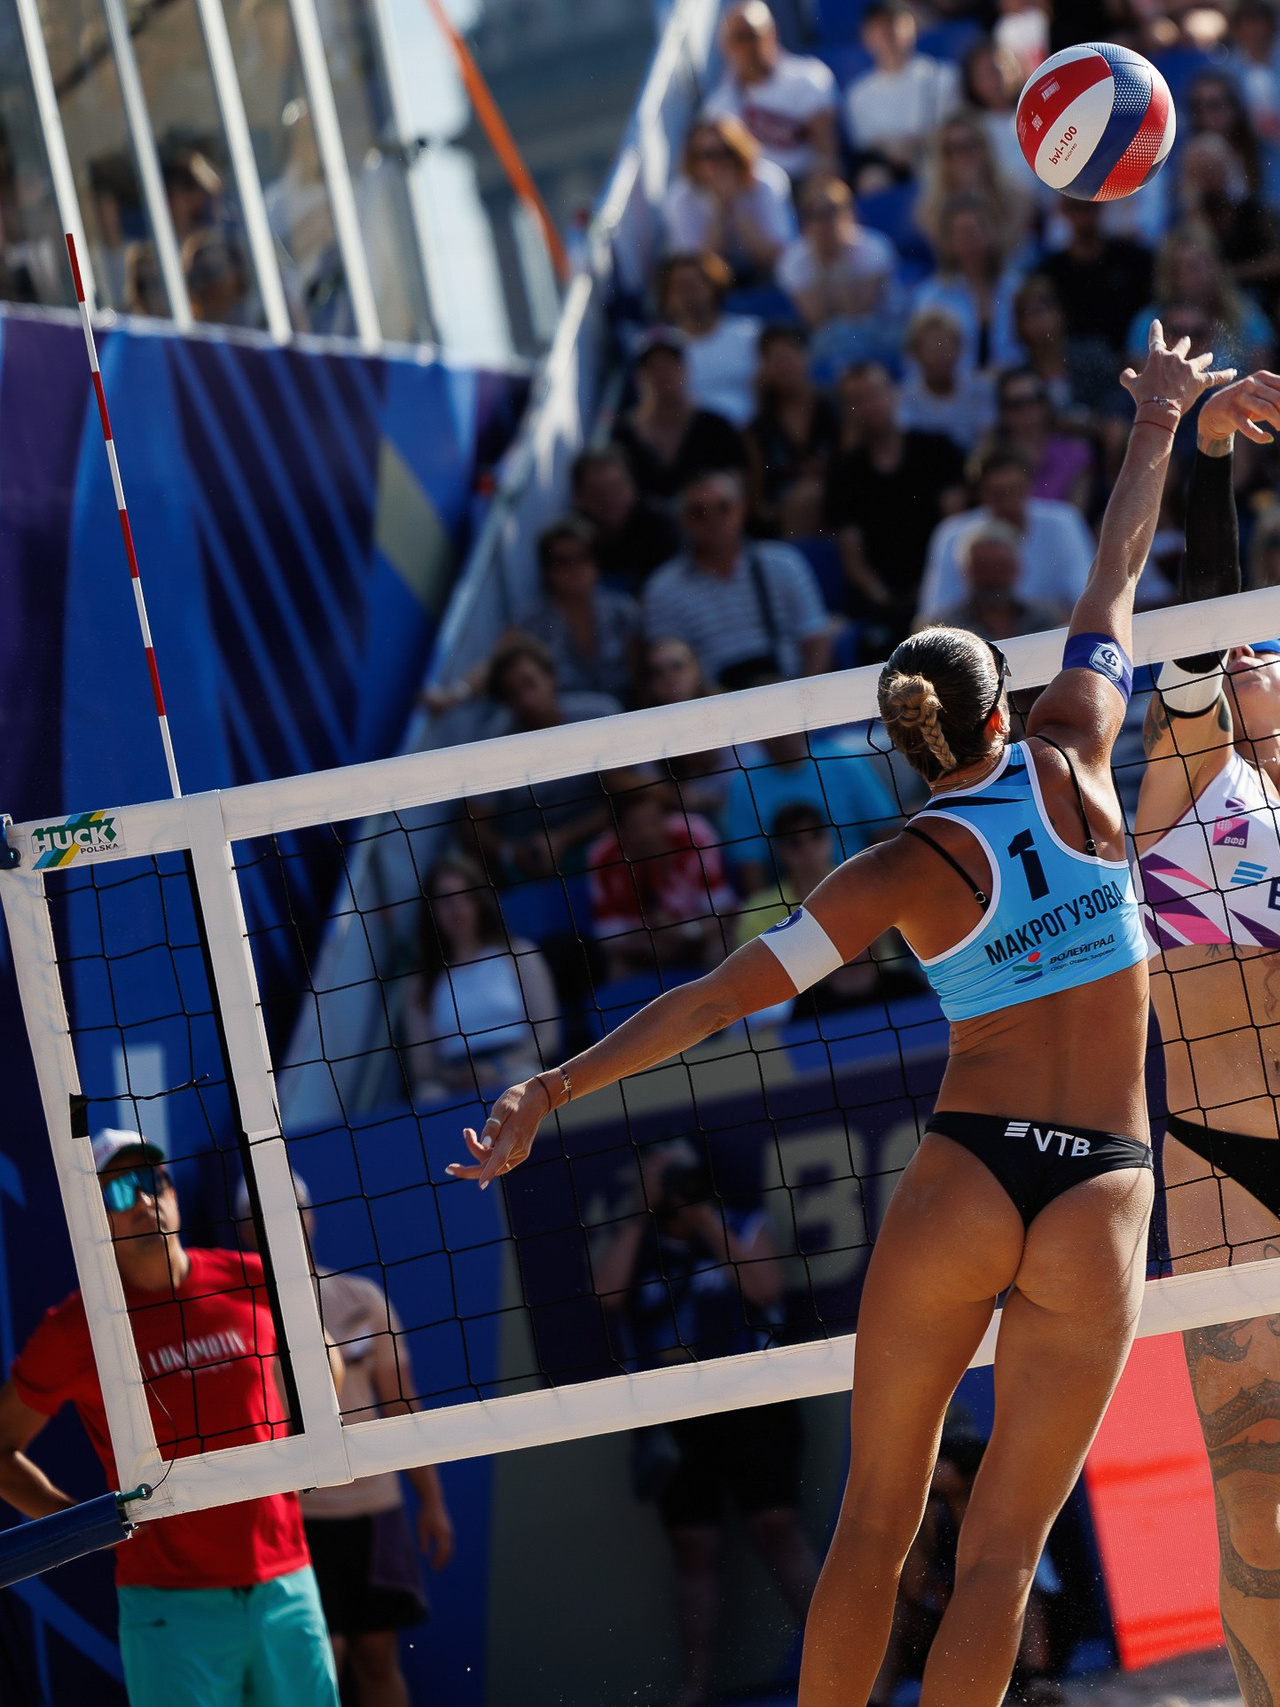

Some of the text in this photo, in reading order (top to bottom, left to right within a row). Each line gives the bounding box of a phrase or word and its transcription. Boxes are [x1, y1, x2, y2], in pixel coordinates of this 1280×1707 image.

[1048, 125, 1078, 165] bvl-100
[31, 818, 117, 854] HUCK
[80, 843, 119, 854] POLSKA
[1223, 836, 1246, 846] ВФВ
[1007, 828, 1050, 902] 1
[984, 881, 1126, 966] МАКРОГУЗОВА
[1049, 934, 1115, 964] ВОЛЕЙГРАД
[1033, 1128, 1091, 1157] VTB
